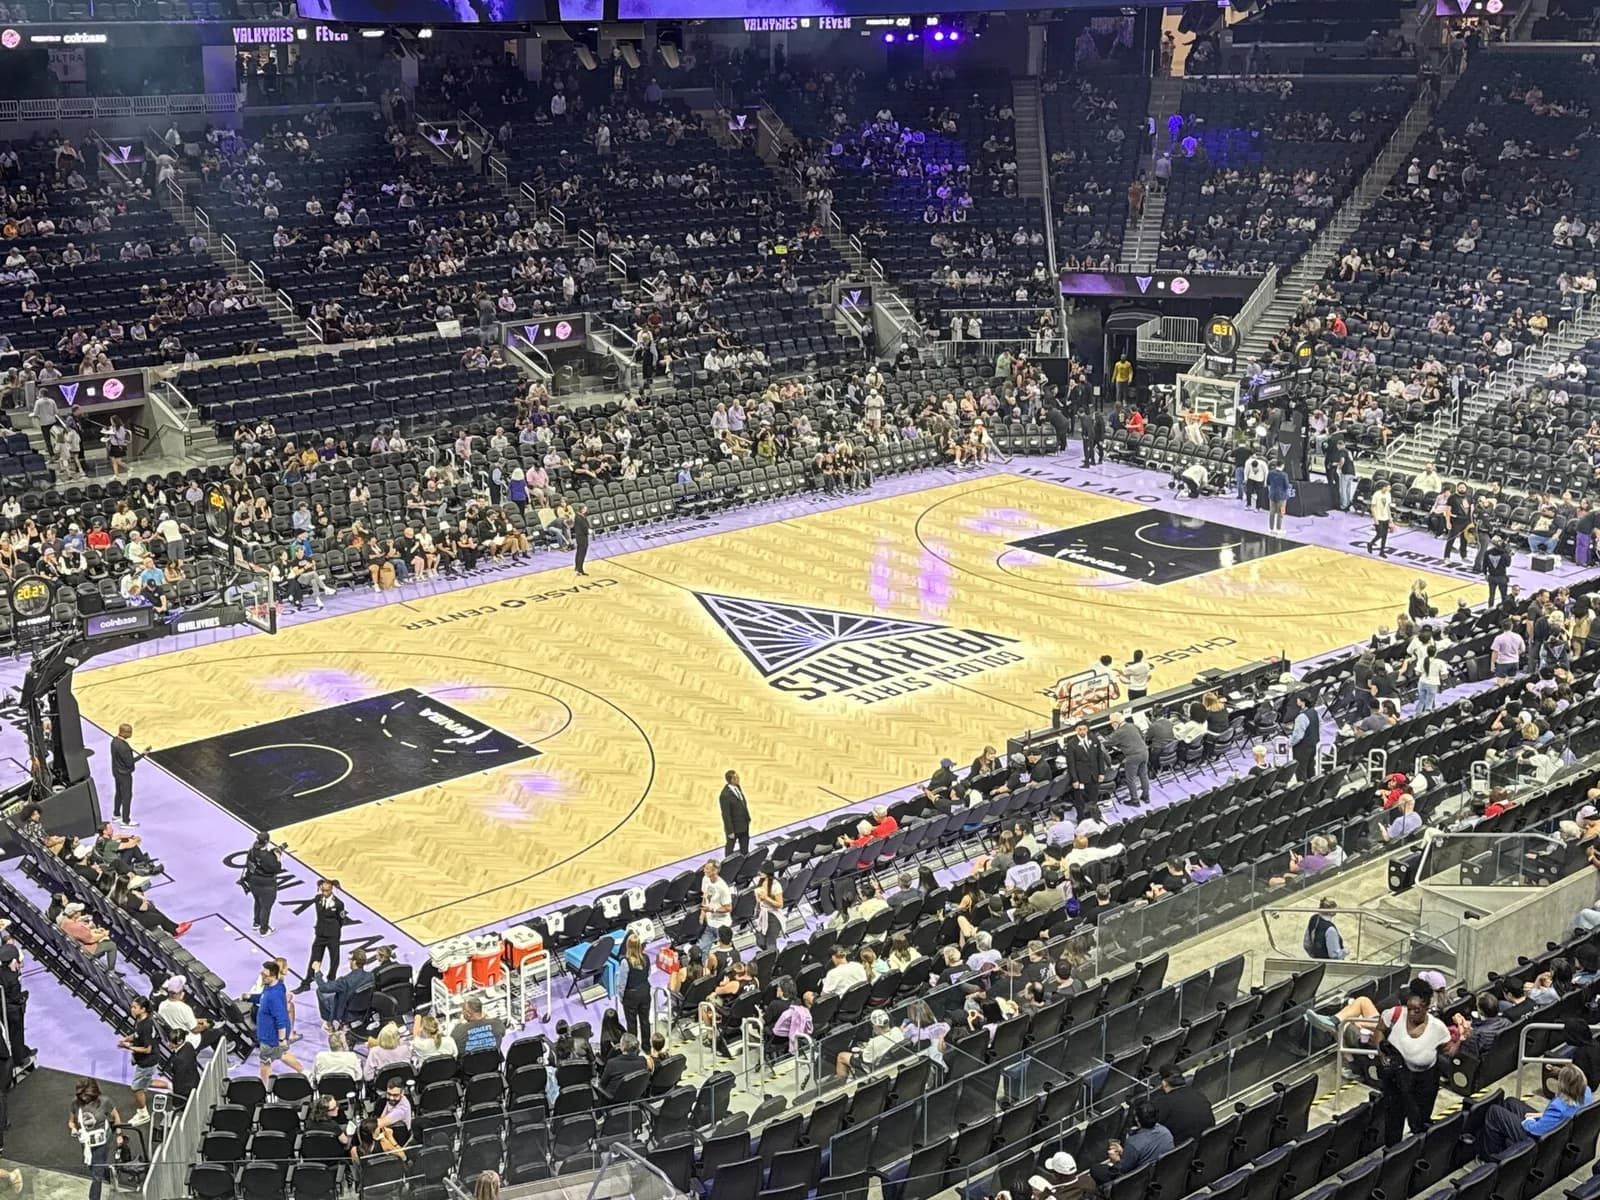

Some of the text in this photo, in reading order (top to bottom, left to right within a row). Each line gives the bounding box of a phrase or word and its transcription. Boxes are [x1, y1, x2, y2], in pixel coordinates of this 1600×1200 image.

[232, 26, 294, 43] VALKYRIES
[744, 18, 797, 31] VALKYRIES
[1018, 467, 1162, 503] WAYMO
[402, 578, 619, 632] CHASE CENTER
[768, 628, 1022, 701] VALKYRIES
[1147, 636, 1237, 665] CHASE
[845, 650, 1024, 705] GOLDEN STATE
[418, 707, 475, 738] WNBA
